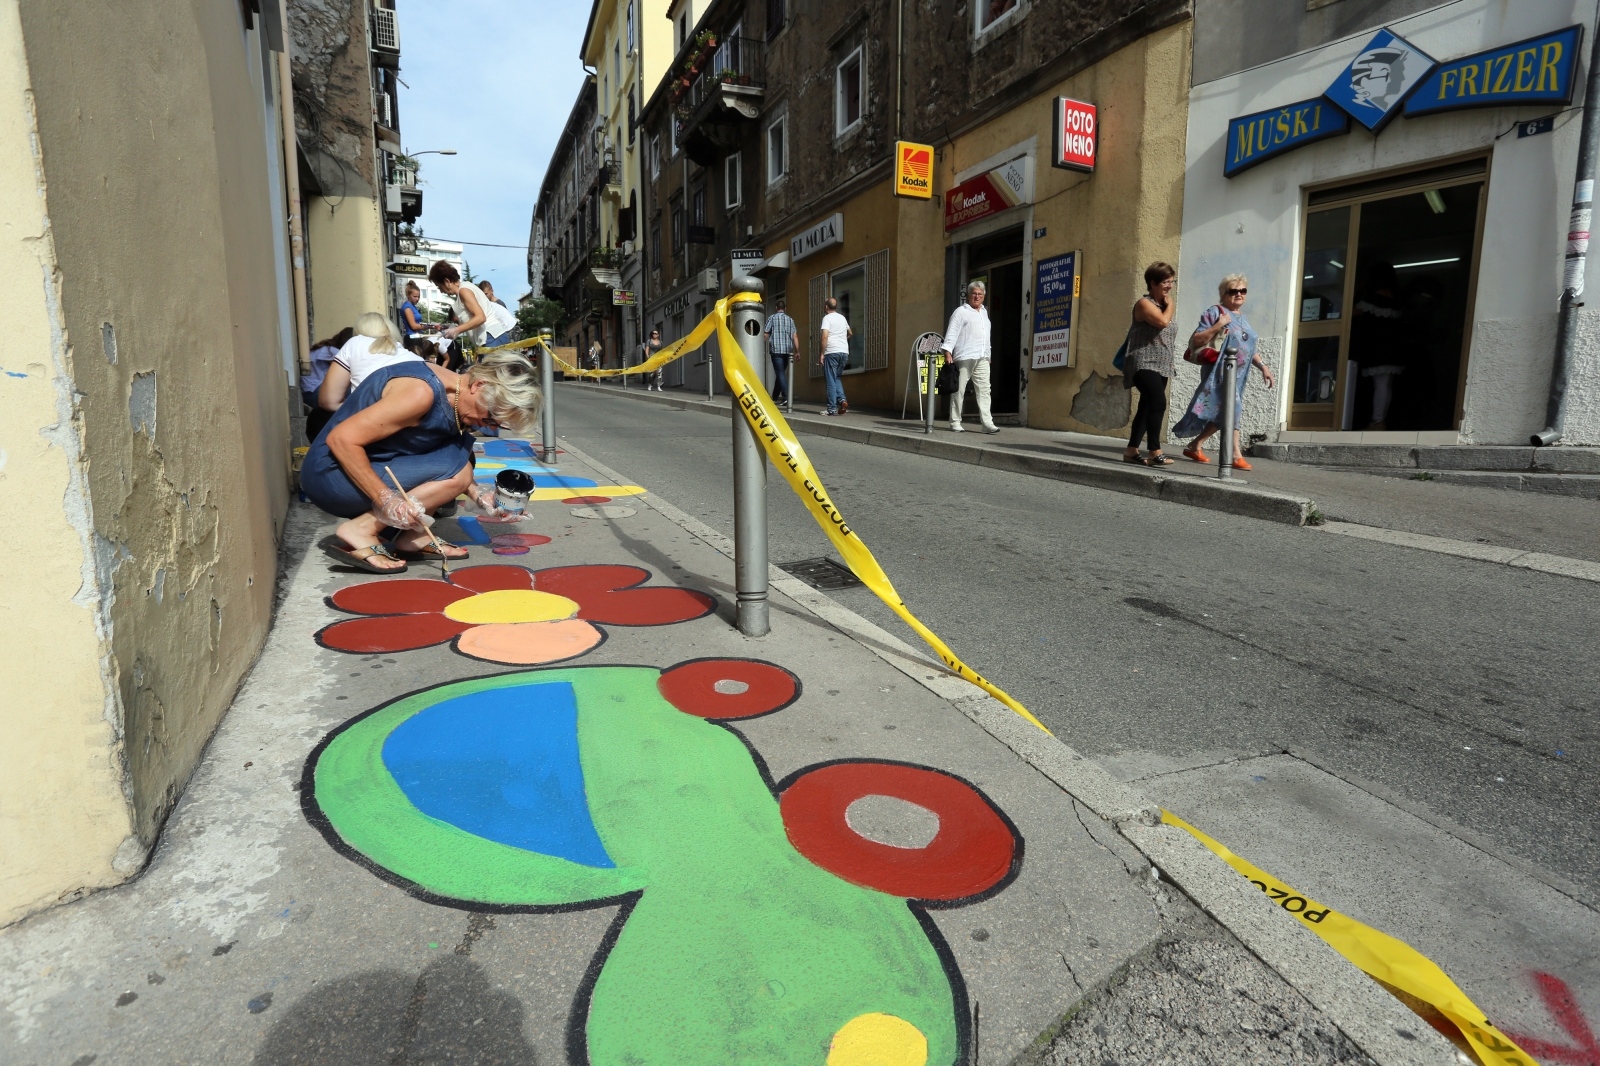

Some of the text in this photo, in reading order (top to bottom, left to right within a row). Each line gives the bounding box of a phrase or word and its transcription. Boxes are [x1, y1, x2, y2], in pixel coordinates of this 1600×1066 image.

[1437, 41, 1564, 99] FRIZER
[1067, 108, 1094, 134] FOTO
[1065, 131, 1094, 157] NENO
[1234, 105, 1322, 163] MUŠKI
[902, 175, 928, 188] Kodak
[1005, 172, 1021, 192] NENO
[1009, 165, 1024, 184] FOTO
[952, 200, 990, 223] EXPRESS
[963, 191, 986, 208] Kodak
[792, 221, 836, 257] DI MODA
[664, 293, 691, 318] CENTRAL
[1037, 355, 1045, 365] ZA
[1051, 353, 1063, 363] SAT
[1244, 874, 1331, 924] POZ
